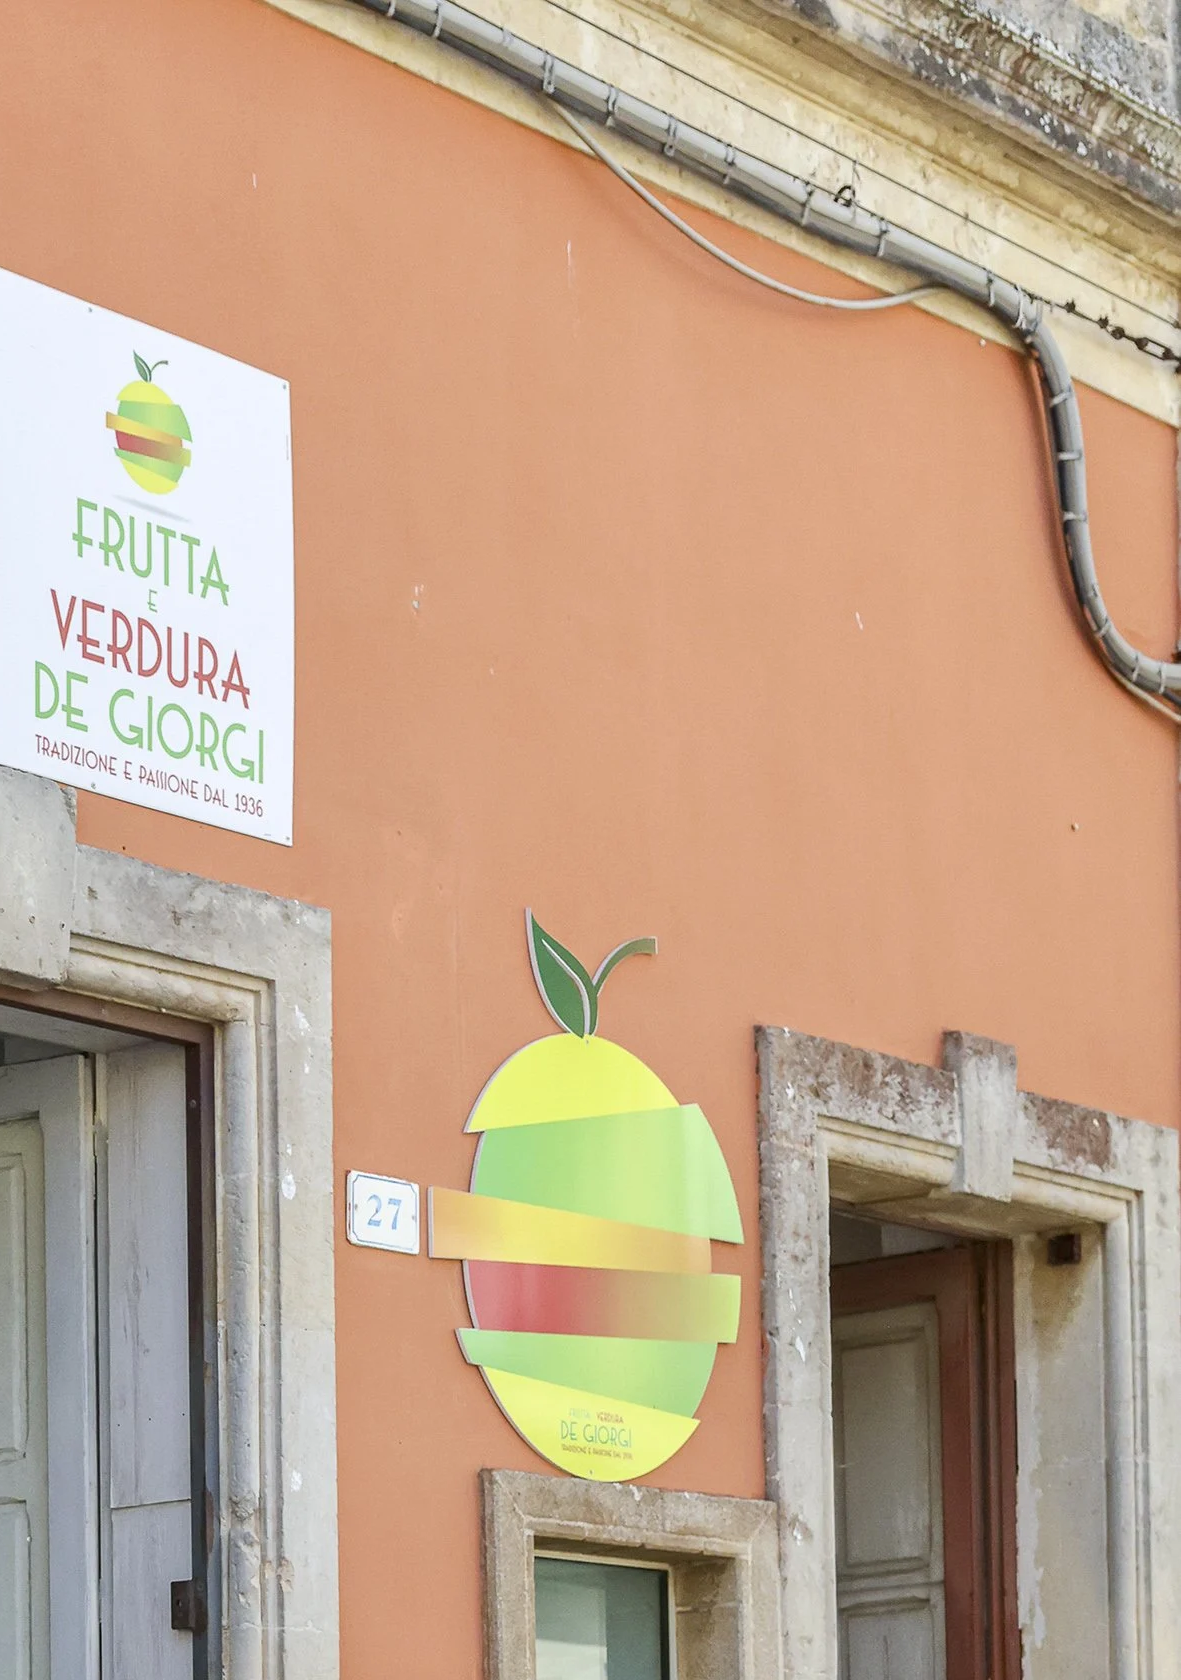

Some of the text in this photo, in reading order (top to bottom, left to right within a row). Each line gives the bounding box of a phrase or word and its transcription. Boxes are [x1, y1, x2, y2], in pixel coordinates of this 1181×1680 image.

[72, 497, 230, 606] FRUTTA
[147, 588, 158, 613] E
[50, 588, 250, 710] VERDURA
[34, 660, 264, 785] DE GIORGI
[35, 734, 264, 818] TRADIZIONE E PASSIONE DAL 1936
[366, 1193, 403, 1231] 27
[560, 1419, 632, 1449] DE GIORGI
